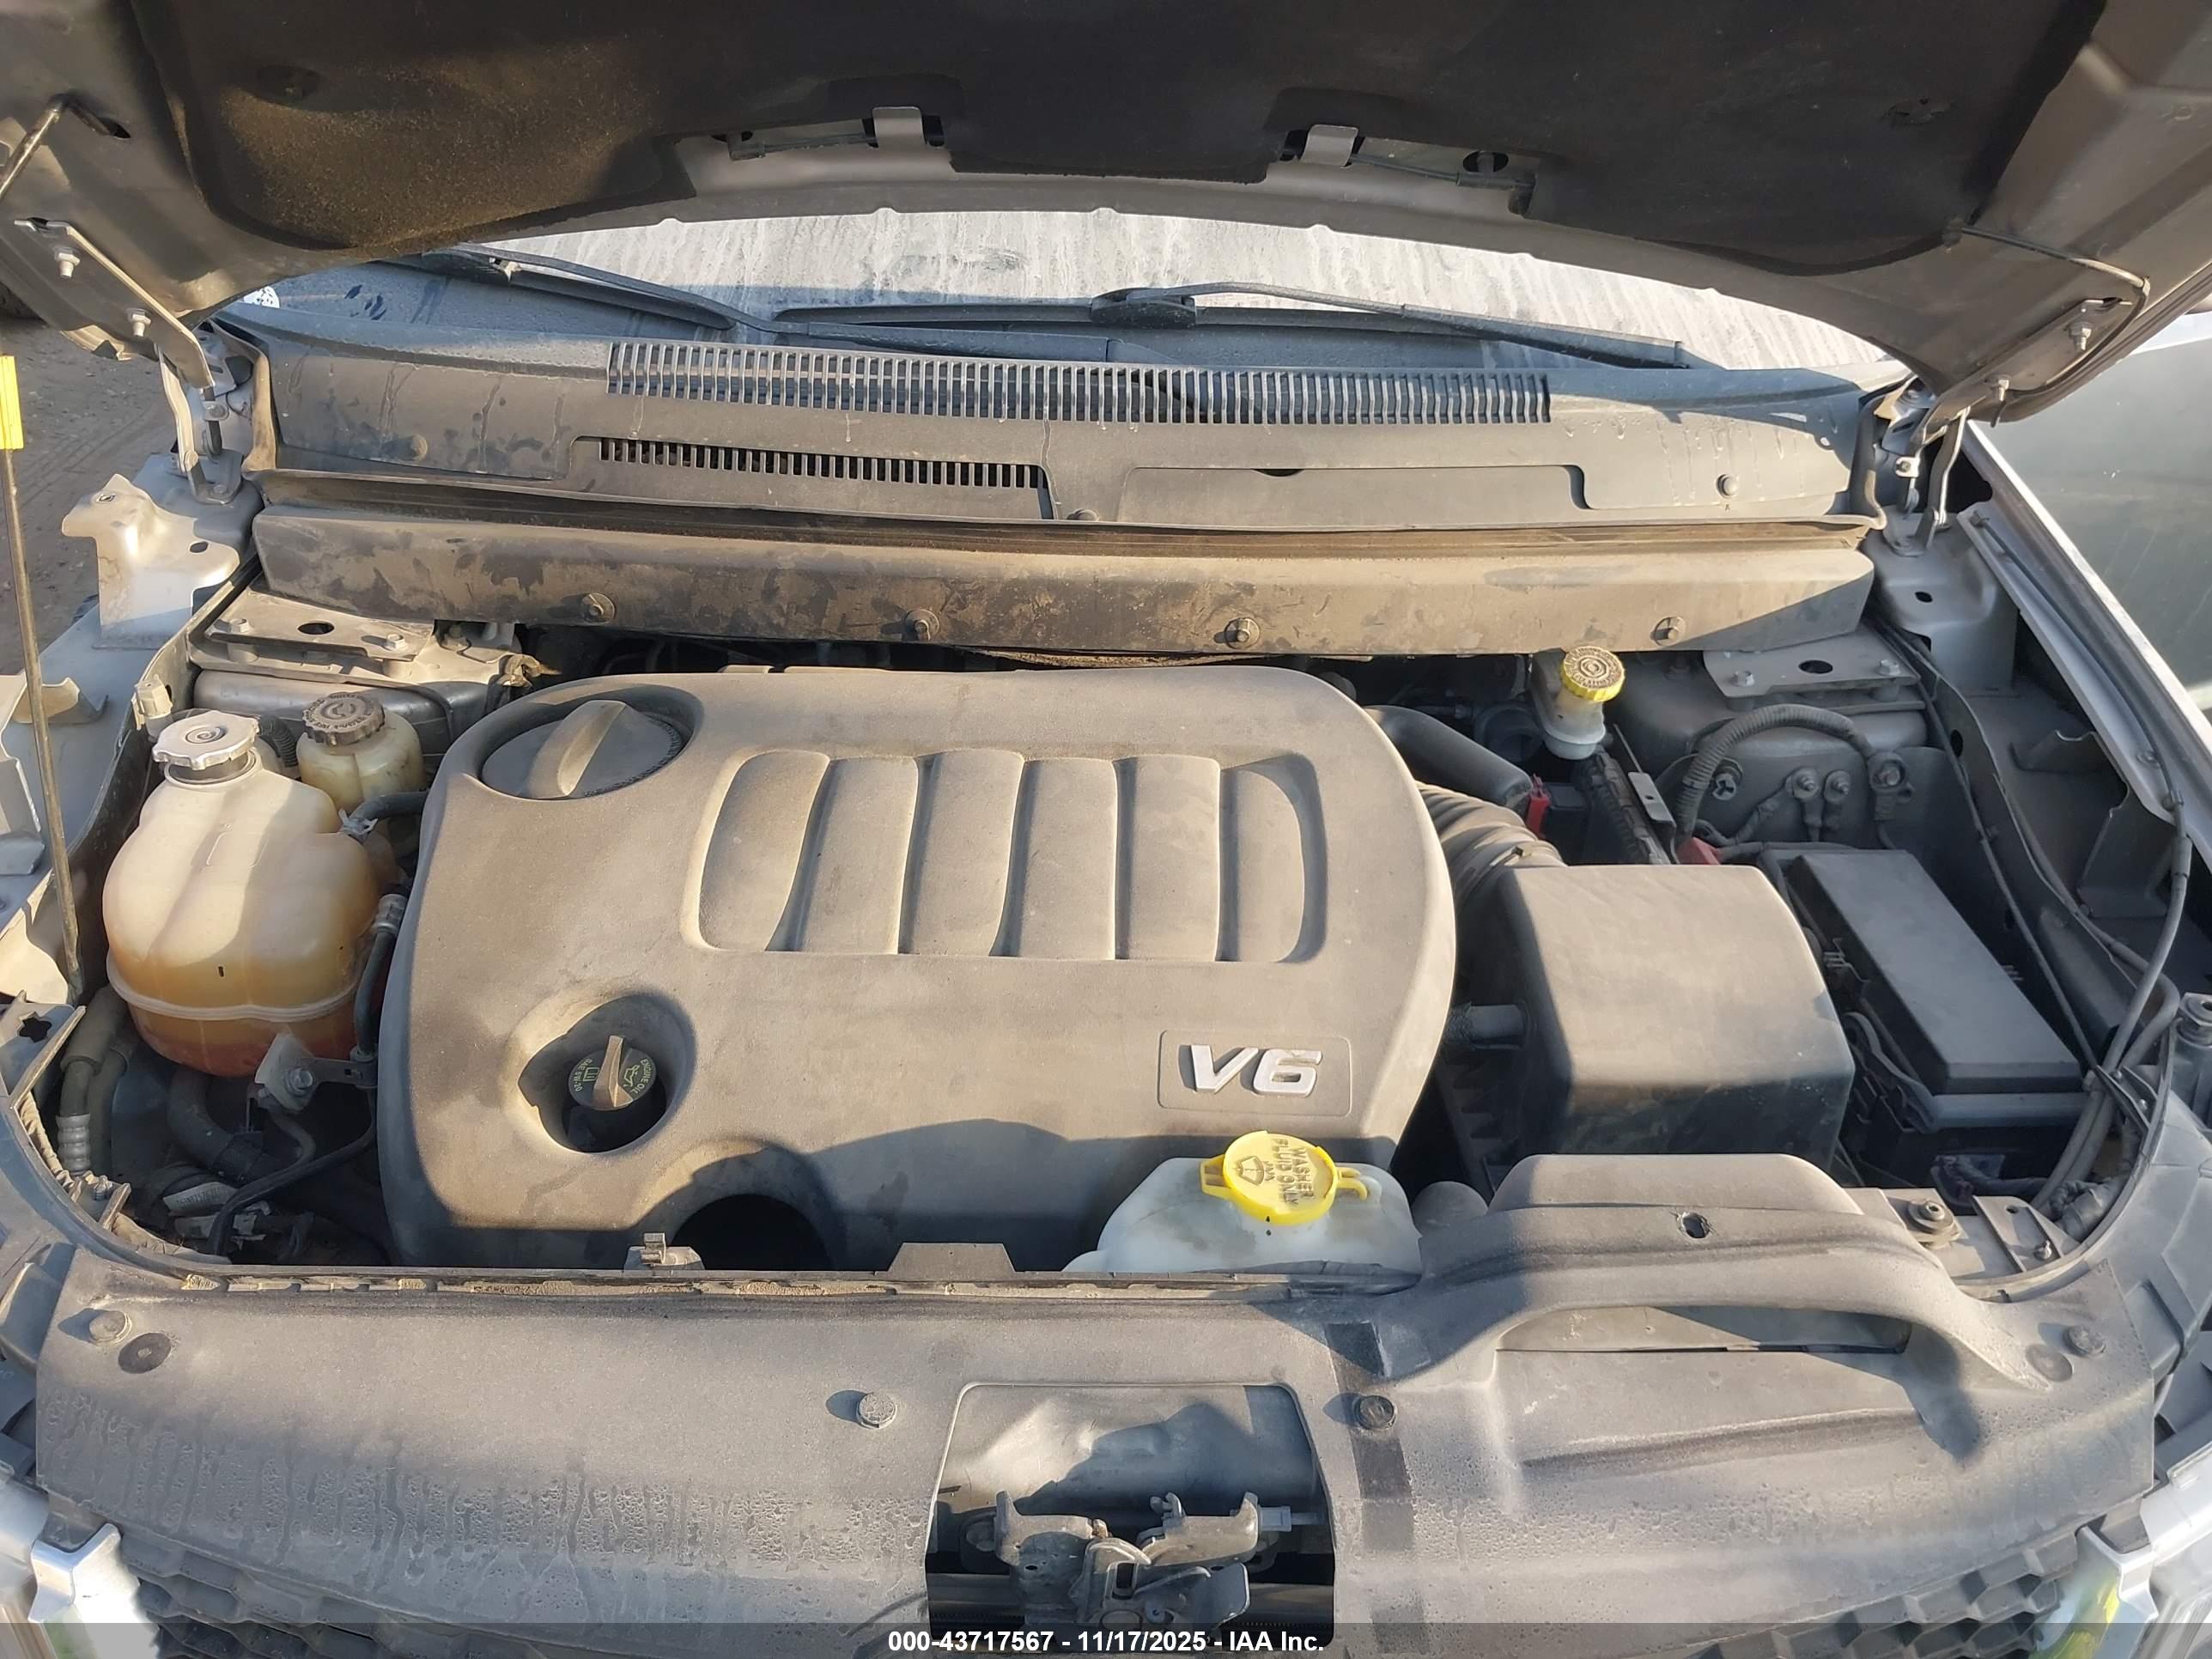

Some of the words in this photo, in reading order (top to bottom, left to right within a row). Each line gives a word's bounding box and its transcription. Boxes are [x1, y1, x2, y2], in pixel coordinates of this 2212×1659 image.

[577, 1057, 592, 1072] SAE
[640, 1058, 652, 1083] ENGINE
[1190, 1043, 1323, 1098] V6
[629, 1083, 646, 1094] OIL
[1272, 1138, 1292, 1171] FLUID
[1291, 1146, 1315, 1200] WASHER
[1276, 1174, 1299, 1206] ONLY
